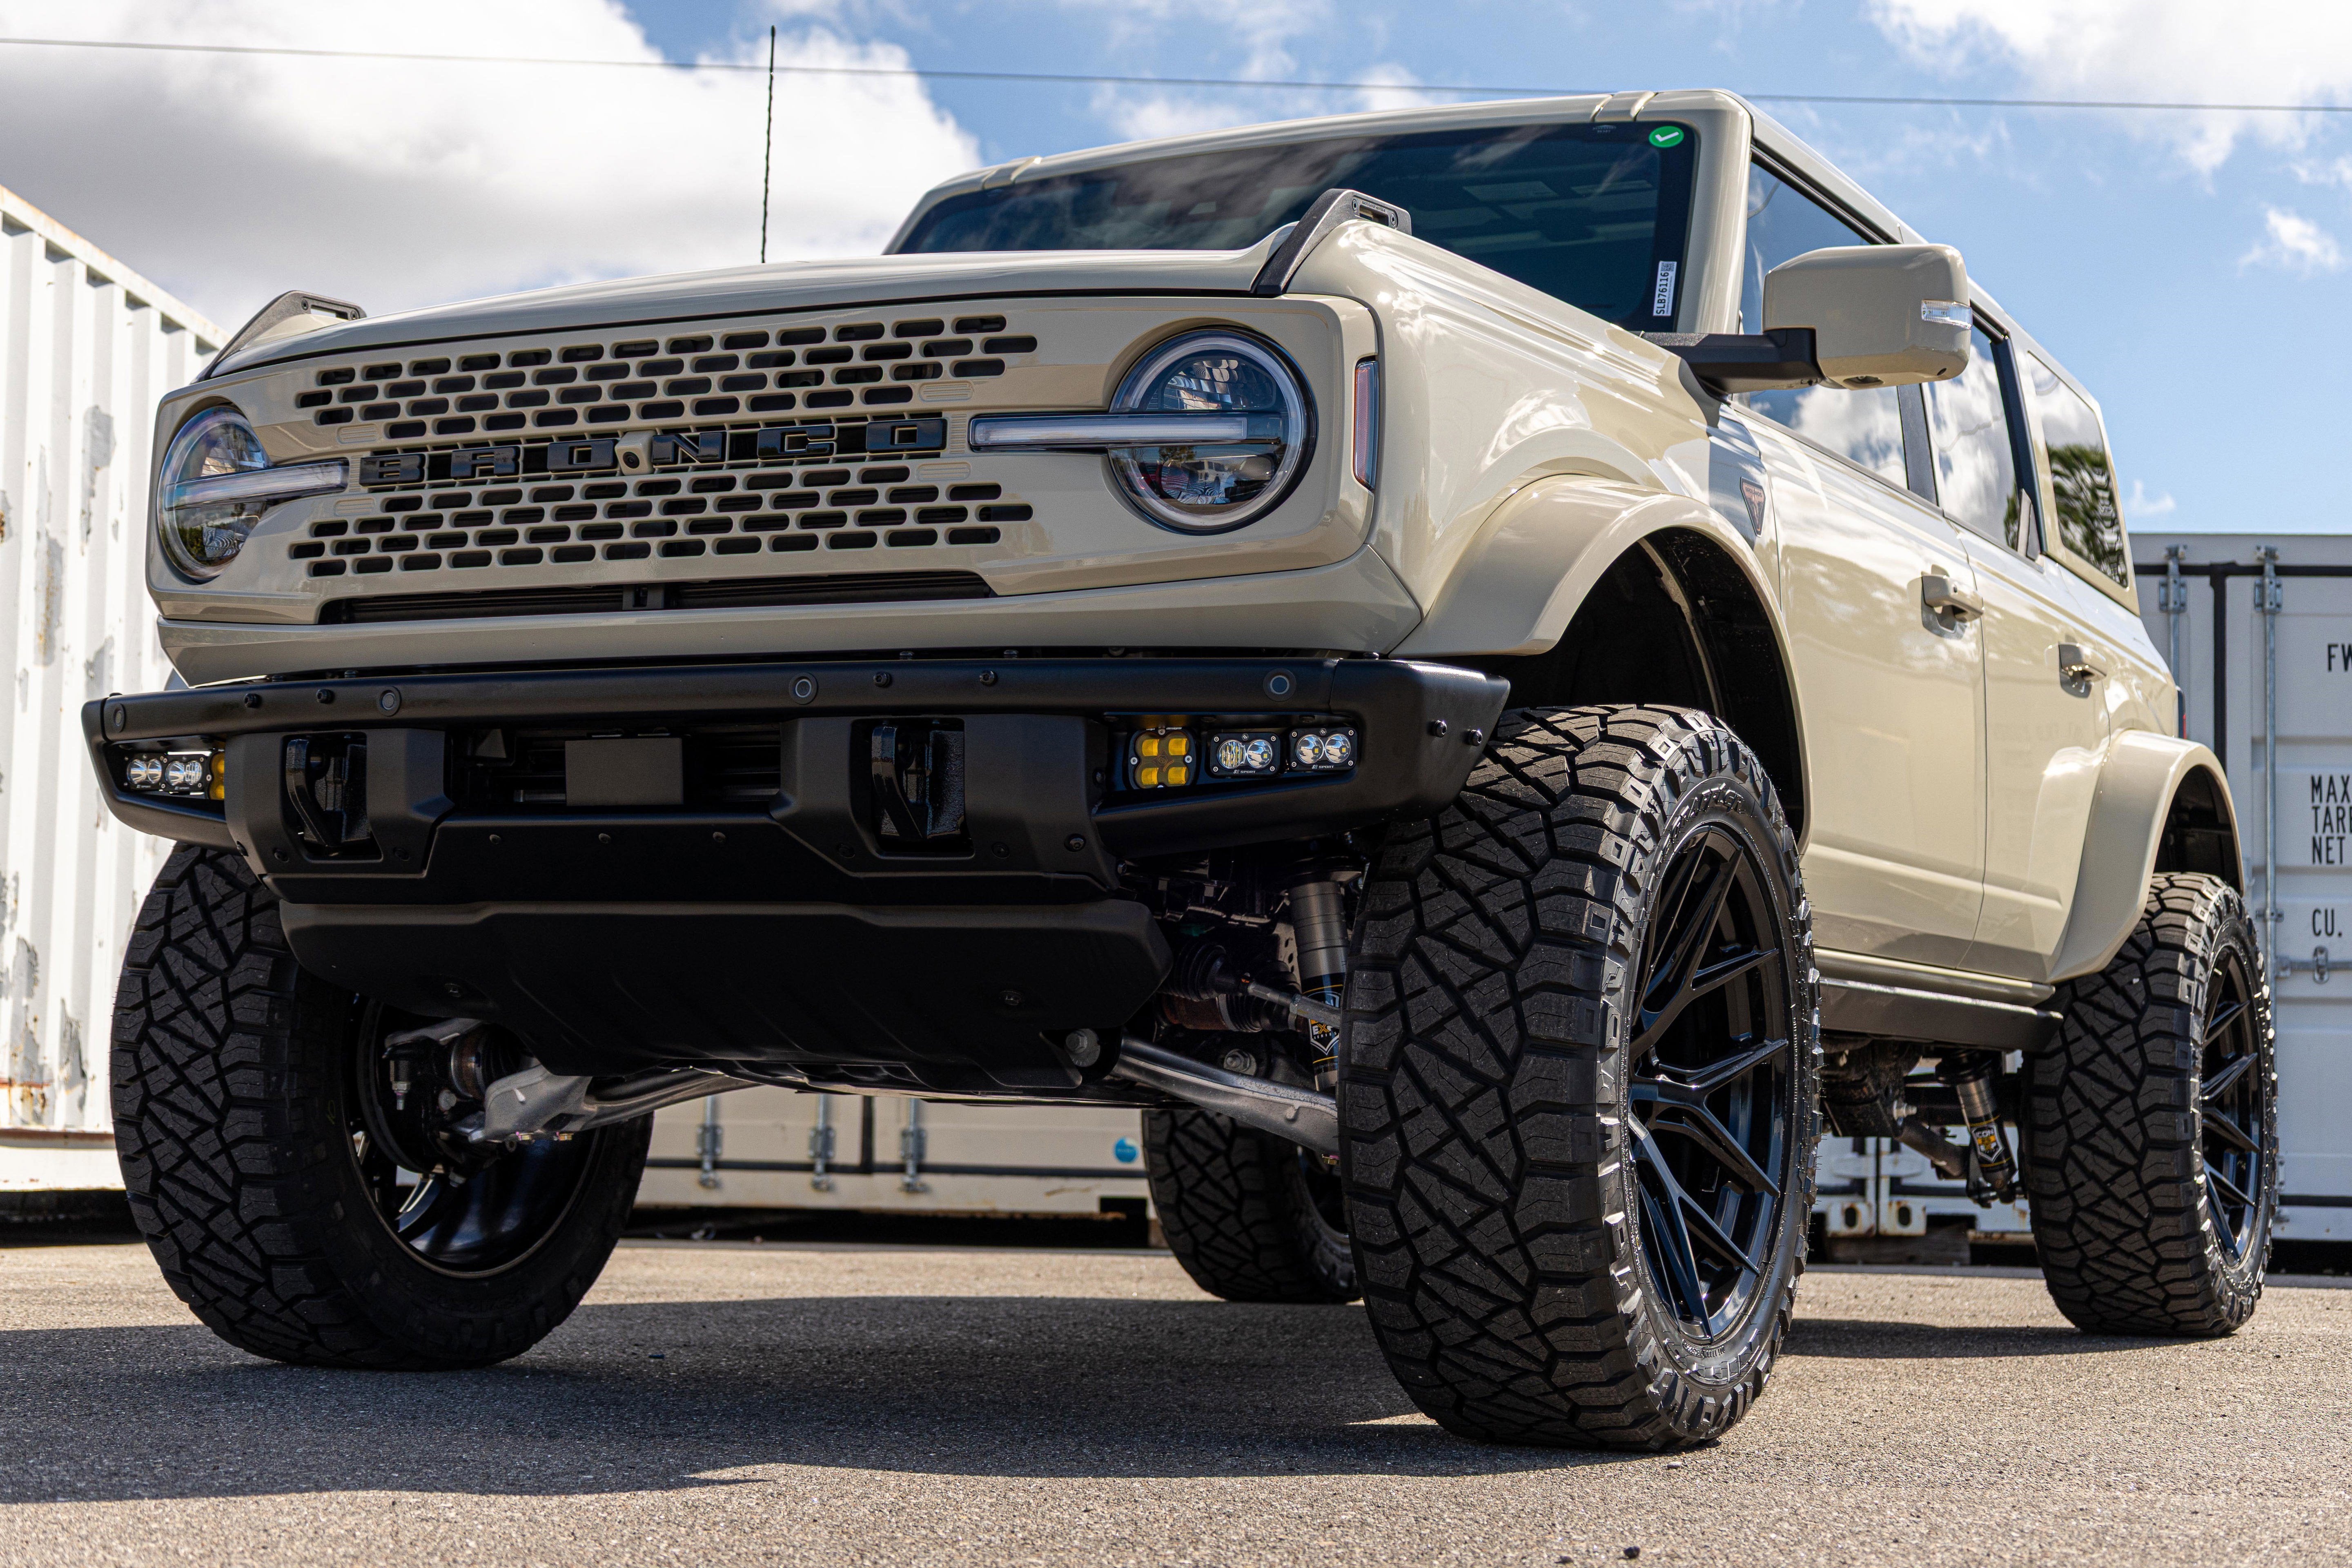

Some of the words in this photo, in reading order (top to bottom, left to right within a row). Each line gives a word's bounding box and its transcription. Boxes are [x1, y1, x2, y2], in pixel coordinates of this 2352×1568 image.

[1656, 272, 1669, 314] SLB76116
[359, 417, 949, 486] BRONCO
[2311, 774, 2351, 803] MAX
[2312, 836, 2346, 864] NET
[2312, 908, 2342, 937] CU.
